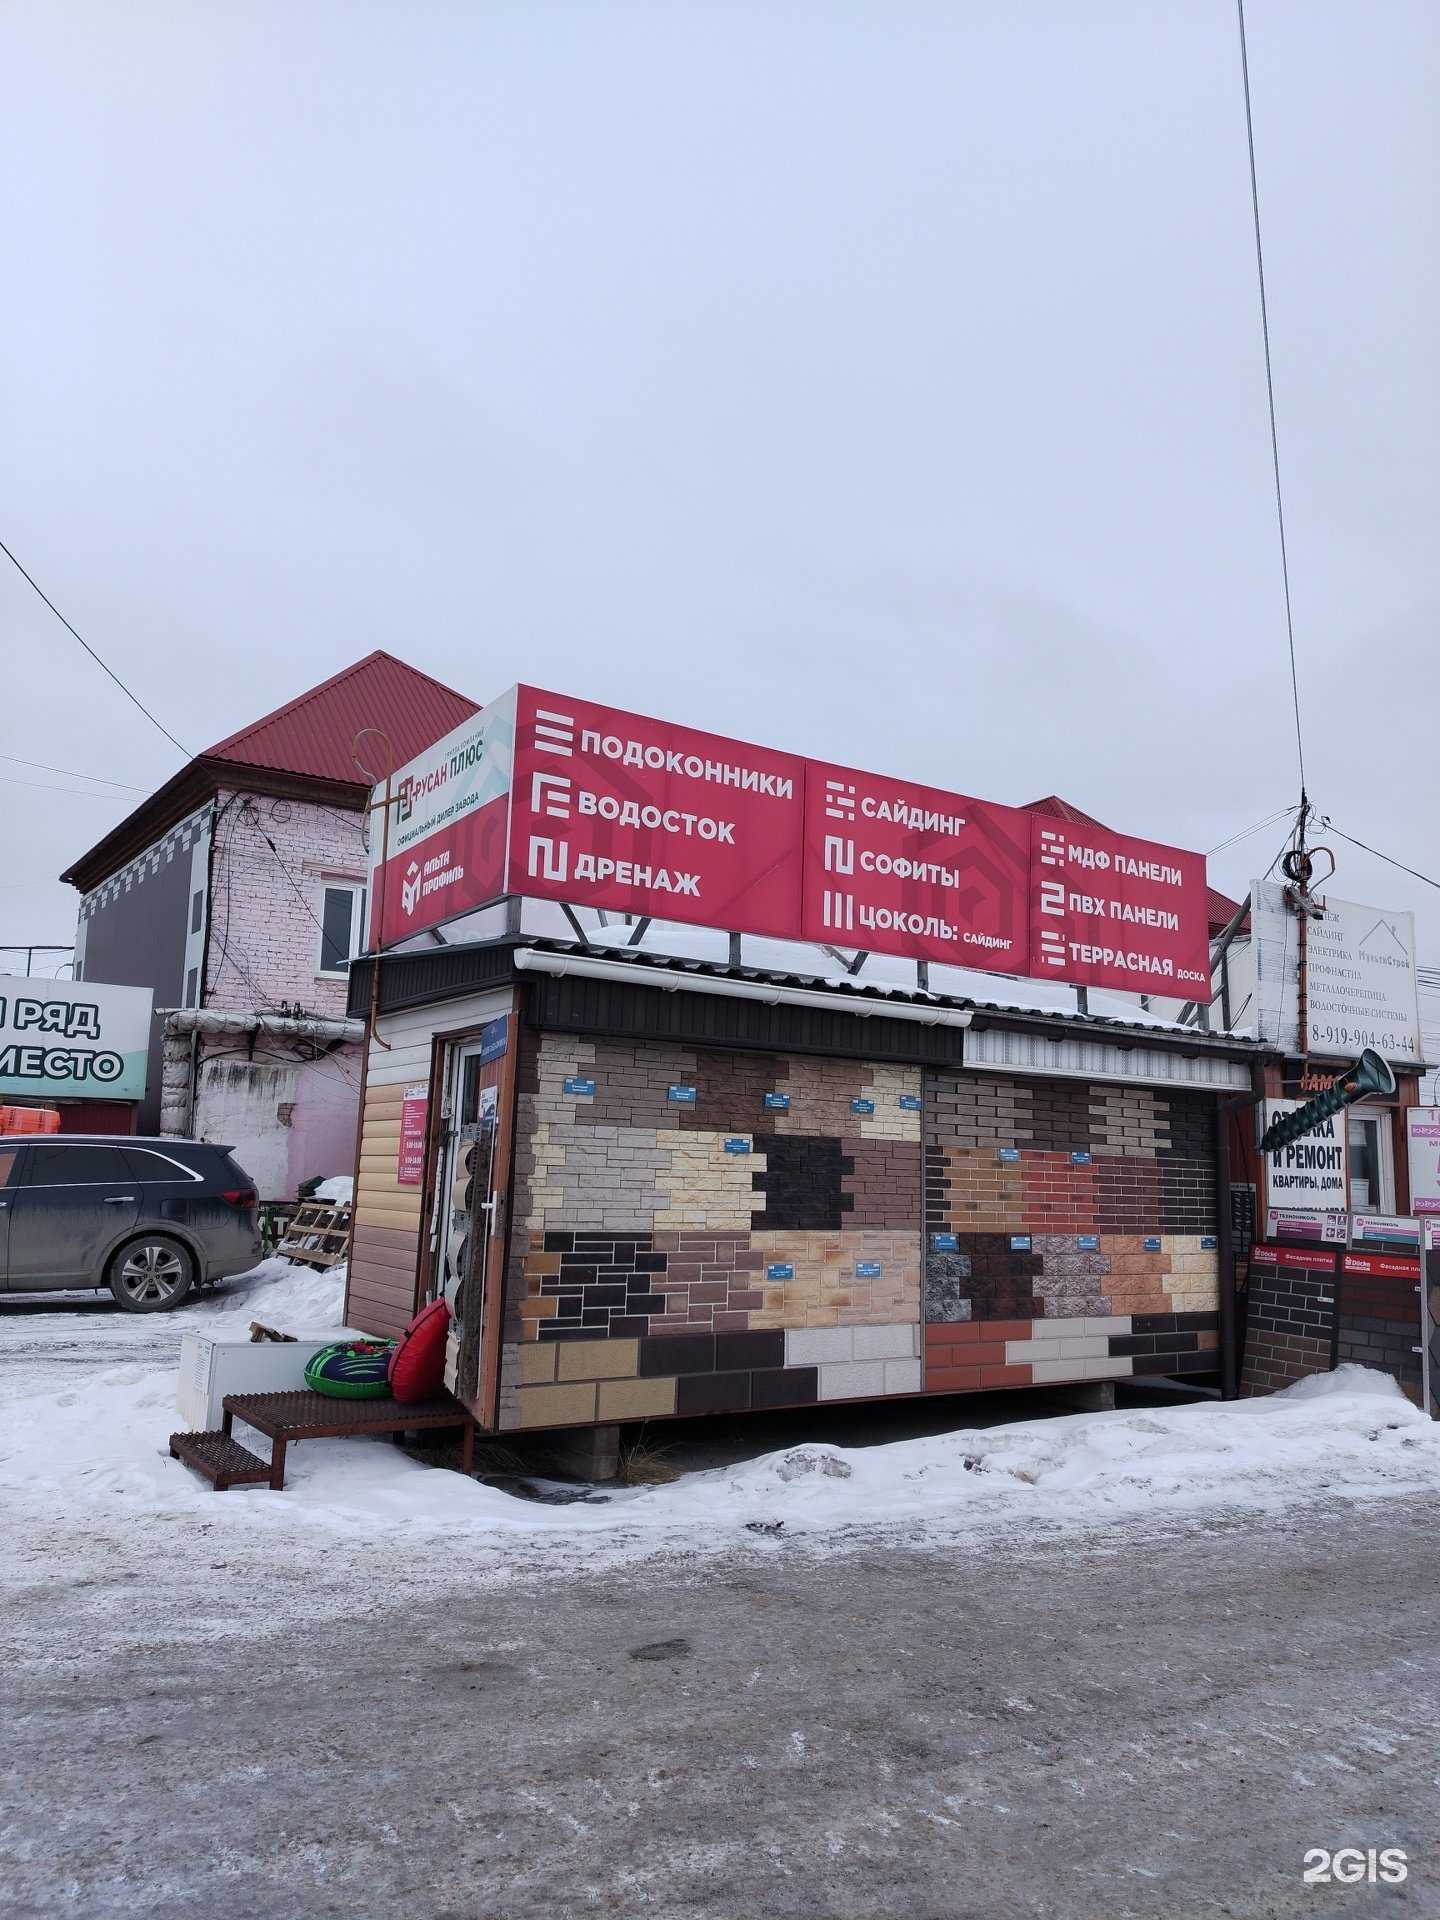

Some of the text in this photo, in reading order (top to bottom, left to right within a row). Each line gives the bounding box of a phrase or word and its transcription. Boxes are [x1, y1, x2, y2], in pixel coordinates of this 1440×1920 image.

[450, 740, 484, 779] ПЛЮС
[581, 729, 793, 800] ПОДОКОННИКИ
[437, 806, 455, 827] ДИЛЕР
[455, 792, 479, 813] ЗАВОДА
[578, 790, 736, 845] ВОДОСТОК
[861, 796, 966, 836] САЙДИНГ
[422, 865, 464, 897] ПРОФИЛЬ
[423, 850, 450, 876] АЛЬТА
[574, 853, 701, 897] ДРЕНАЖ
[860, 851, 960, 889] СОФИТЫ
[1068, 845, 1182, 887] МДФ ПАНЕЛИ
[859, 904, 1013, 950] ЦОКОЛЬ: САЙДИНГ
[1069, 893, 1179, 931] ПВХ ПАНЕЛИ
[1068, 942, 1206, 983] ТЕРРАСНАЯ ДОСКА
[1308, 945, 1353, 961] ЭЛЕКТРИКА
[1308, 963, 1362, 980] ПРОФНАСТИЛ
[14, 998, 101, 1040] РЯД
[1312, 1024, 1415, 1053] 8-919-904-63-44
[1286, 1145, 1343, 1170] РЕМОНТ
[1273, 1174, 1344, 1191] КВАРТИРЫ, ДОМА
